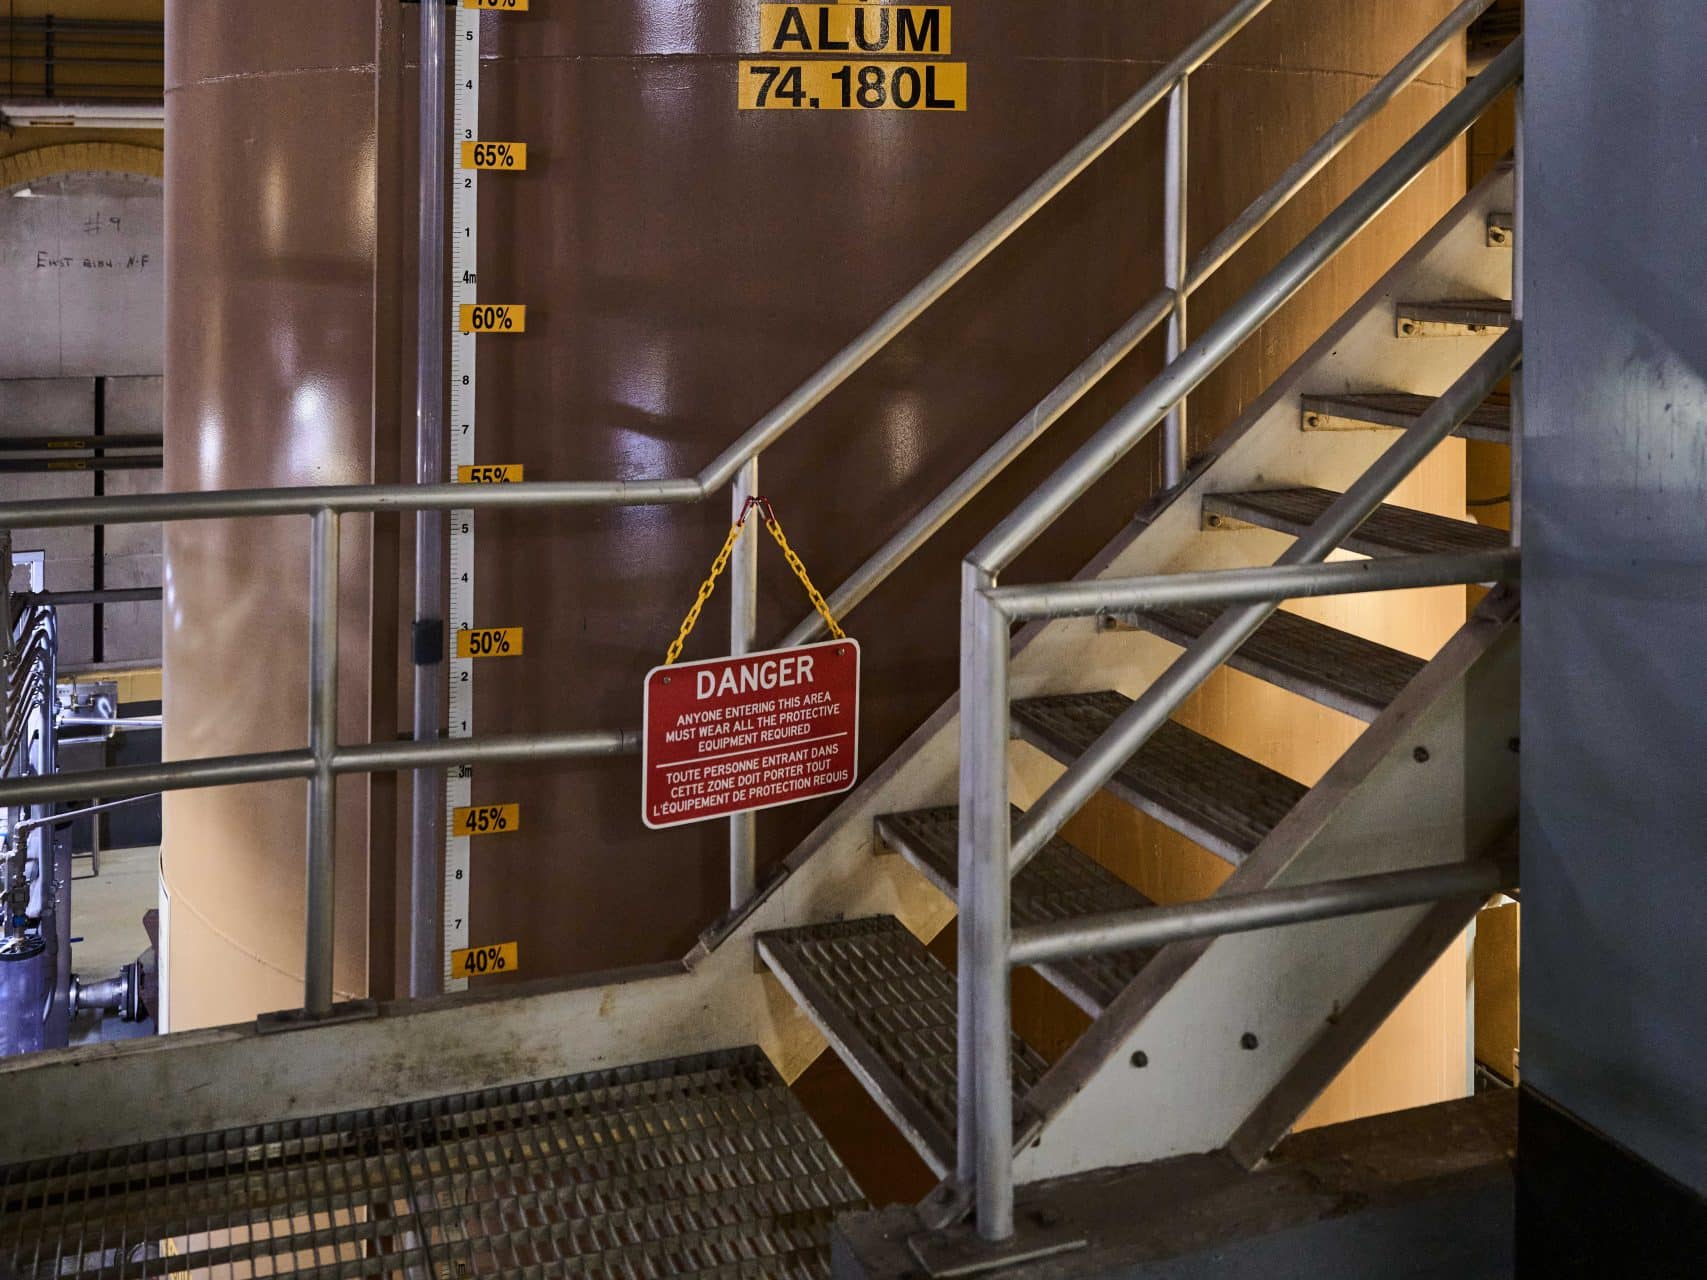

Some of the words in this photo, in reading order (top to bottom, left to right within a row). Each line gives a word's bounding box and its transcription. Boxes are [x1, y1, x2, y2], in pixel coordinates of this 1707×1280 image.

[772, 6, 940, 52] ALUM
[466, 31, 473, 41] 5
[466, 80, 472, 90] 4
[466, 129, 472, 139] 3
[474, 144, 514, 166] 65%
[465, 178, 472, 188] 2
[465, 227, 470, 237] 1
[463, 270, 477, 284] 4m
[472, 307, 512, 329] 60%
[463, 375, 470, 385] 8
[461, 425, 469, 434] 7
[461, 524, 469, 533] 5
[461, 573, 468, 582] 4
[461, 622, 468, 630] 3
[470, 630, 510, 654] 50%
[461, 672, 468, 681] 2
[696, 655, 814, 700] DANGER
[677, 708, 722, 727] ANYONE
[725, 700, 776, 719] ENTERING
[778, 697, 801, 710] THIS
[803, 691, 832, 706] AREA
[461, 721, 466, 731] 1
[665, 729, 696, 743] MUST
[698, 723, 730, 737] WEAR
[733, 720, 753, 731] ALL
[757, 715, 776, 727] THE
[779, 704, 840, 724] PROTECTIVE
[698, 734, 758, 753] EQUIPMENT
[760, 724, 811, 741] REQUIRED
[666, 770, 701, 785] TOUTE
[704, 760, 759, 778] PERSONNE
[762, 749, 809, 767] ENTRANT
[811, 744, 839, 758] DANS
[459, 765, 472, 778] 3m
[671, 784, 704, 798] CETTE
[707, 778, 735, 792] ZONE
[738, 773, 760, 785] DOIT
[763, 765, 803, 781] PORTER
[806, 758, 832, 773] TOUT
[653, 795, 730, 816] L'ÉQUIPEMENT
[733, 789, 746, 802] DE
[749, 778, 811, 798] PROTECTION
[813, 770, 848, 786] REQUIS
[466, 807, 506, 831] 45%
[456, 870, 462, 879] 8
[455, 919, 462, 929] 7
[464, 947, 505, 973] 40%
